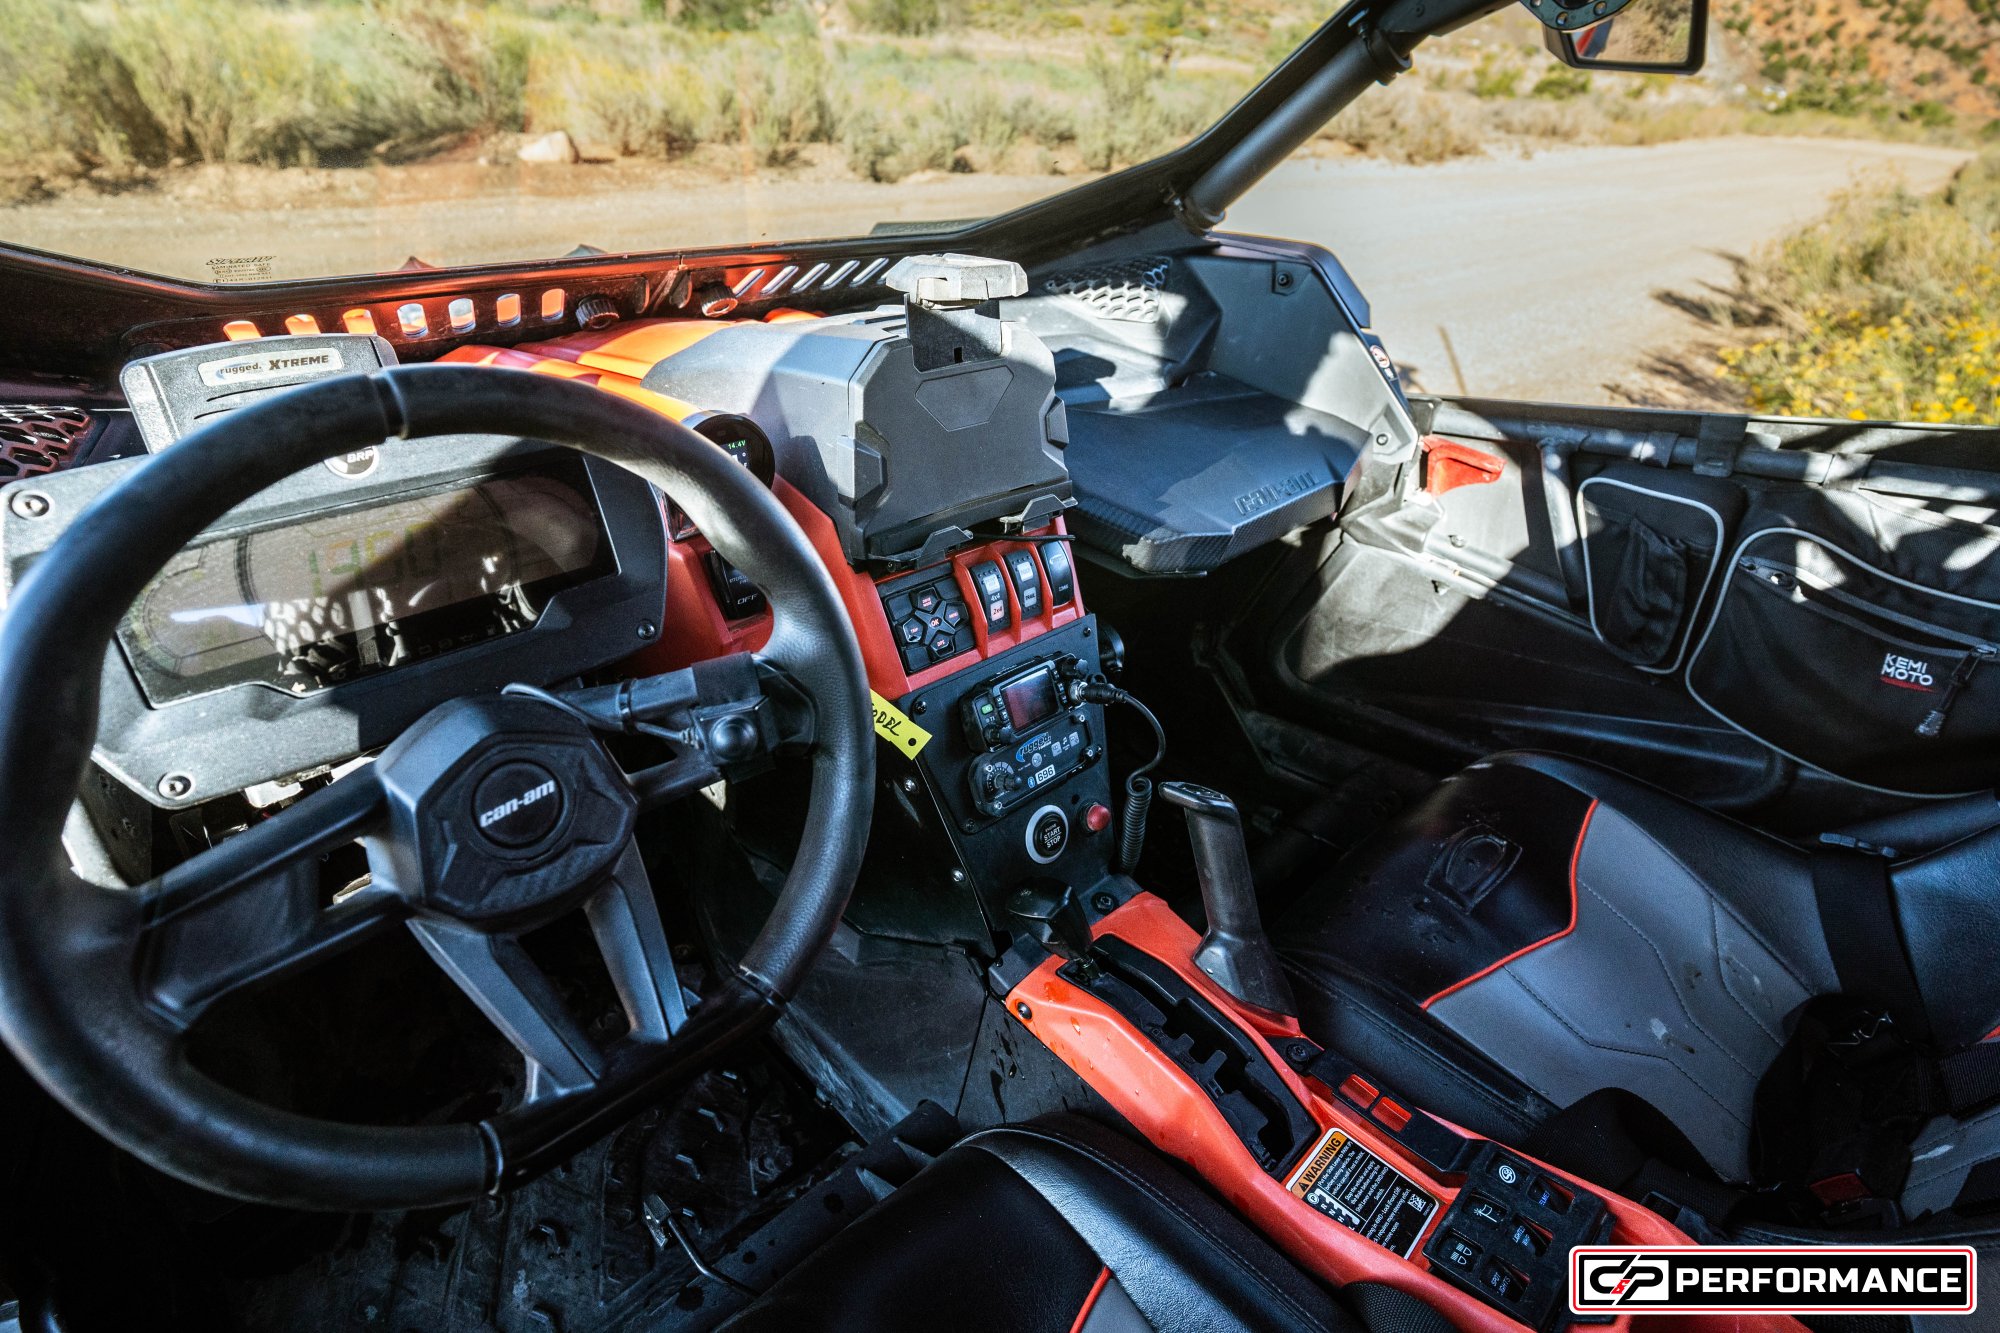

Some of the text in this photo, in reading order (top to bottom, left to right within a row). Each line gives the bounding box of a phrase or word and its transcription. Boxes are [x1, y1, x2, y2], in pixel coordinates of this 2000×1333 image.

[269, 355, 329, 370] XTREME
[347, 448, 374, 463] BRP
[991, 593, 1000, 602] 4x4
[992, 606, 1004, 615] 2x4
[931, 618, 940, 627] OK
[1884, 653, 1927, 674] KEMI
[1881, 664, 1933, 686] MOTO
[1037, 766, 1054, 782] 696
[480, 780, 555, 828] can-am
[1044, 826, 1061, 841] START
[1046, 836, 1061, 848] STOP
[1303, 1138, 1340, 1183] WARNING
[1490, 1271, 1501, 1287] SPOT
